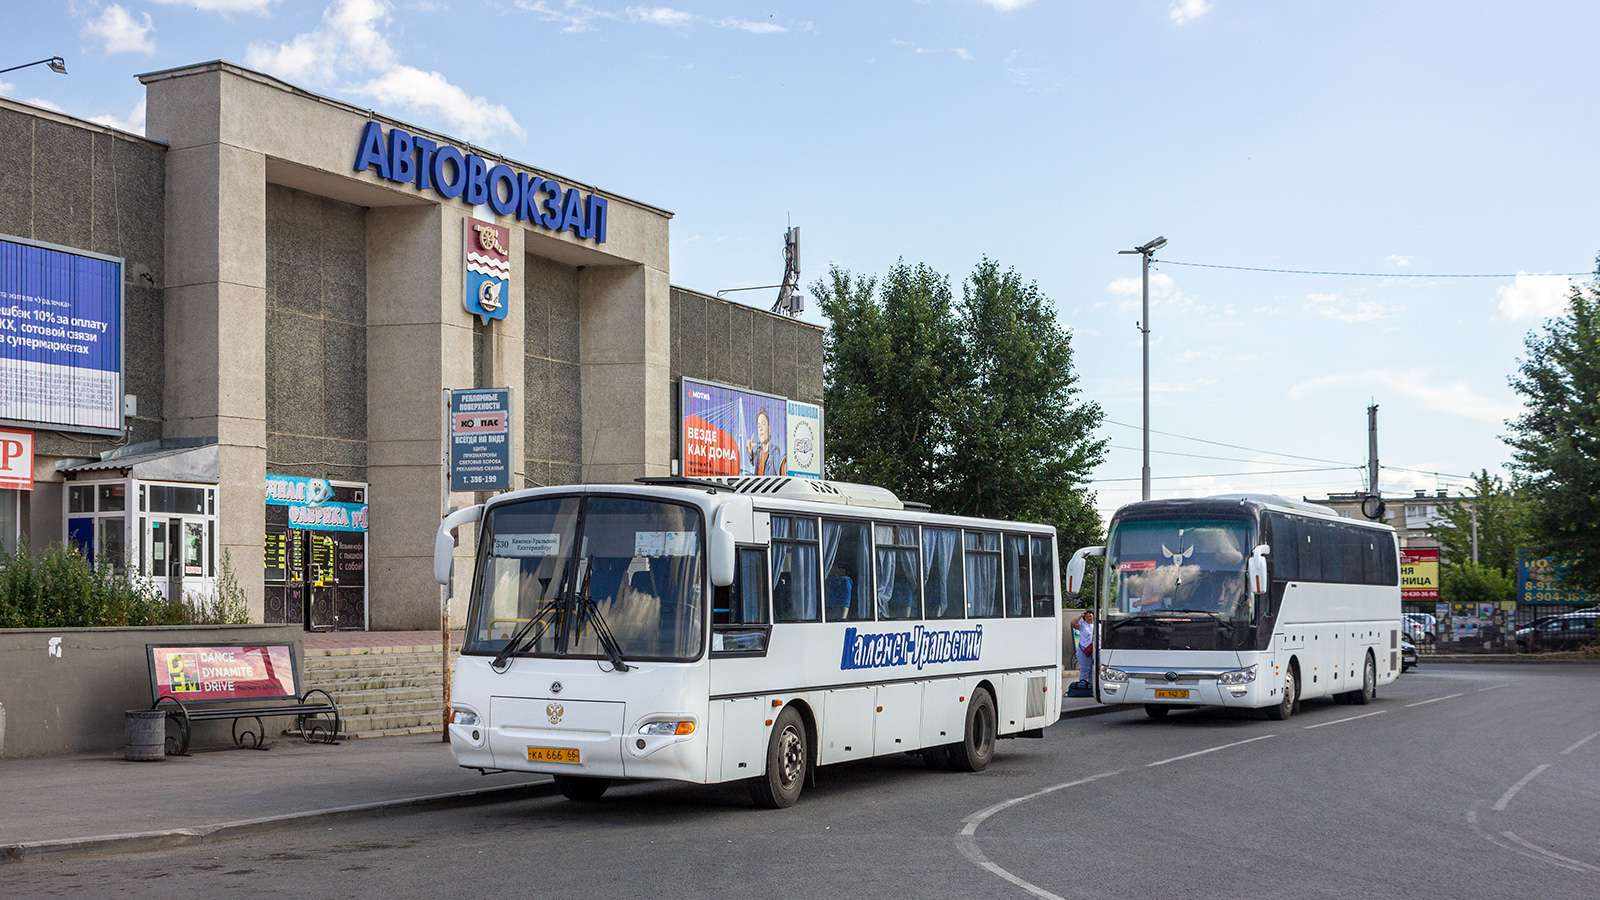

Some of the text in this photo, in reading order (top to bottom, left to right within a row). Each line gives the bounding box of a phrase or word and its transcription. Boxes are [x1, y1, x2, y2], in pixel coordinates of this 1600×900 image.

[353, 121, 608, 243] АВТОВОКЗАЛ
[33, 310, 55, 323] 10%
[57, 315, 69, 325] за
[71, 317, 108, 333] оплату
[21, 323, 65, 338] сотовой
[67, 330, 98, 342] связи
[7, 335, 89, 354] супермаркетах
[461, 393, 498, 402] РЕКЛАМНЫЕ
[459, 402, 500, 411] ПОВЕРХНОСТИ
[787, 402, 819, 419] АВТОШКОЛА
[455, 434, 505, 444] ВСЕГДА НА ВИДУ
[688, 427, 717, 444] ВЕЗДЕ
[688, 443, 737, 461] КАК ДОМА
[290, 505, 350, 527] ФАБРИКА
[495, 540, 509, 549] 530
[1401, 567, 1414, 575] НЯ
[1402, 577, 1431, 586] НИЦА
[200, 652, 235, 663] DANCE
[202, 667, 253, 678] DYNAMITE
[204, 681, 235, 692] DRIVE
[532, 750, 576, 760] КА 666 66
